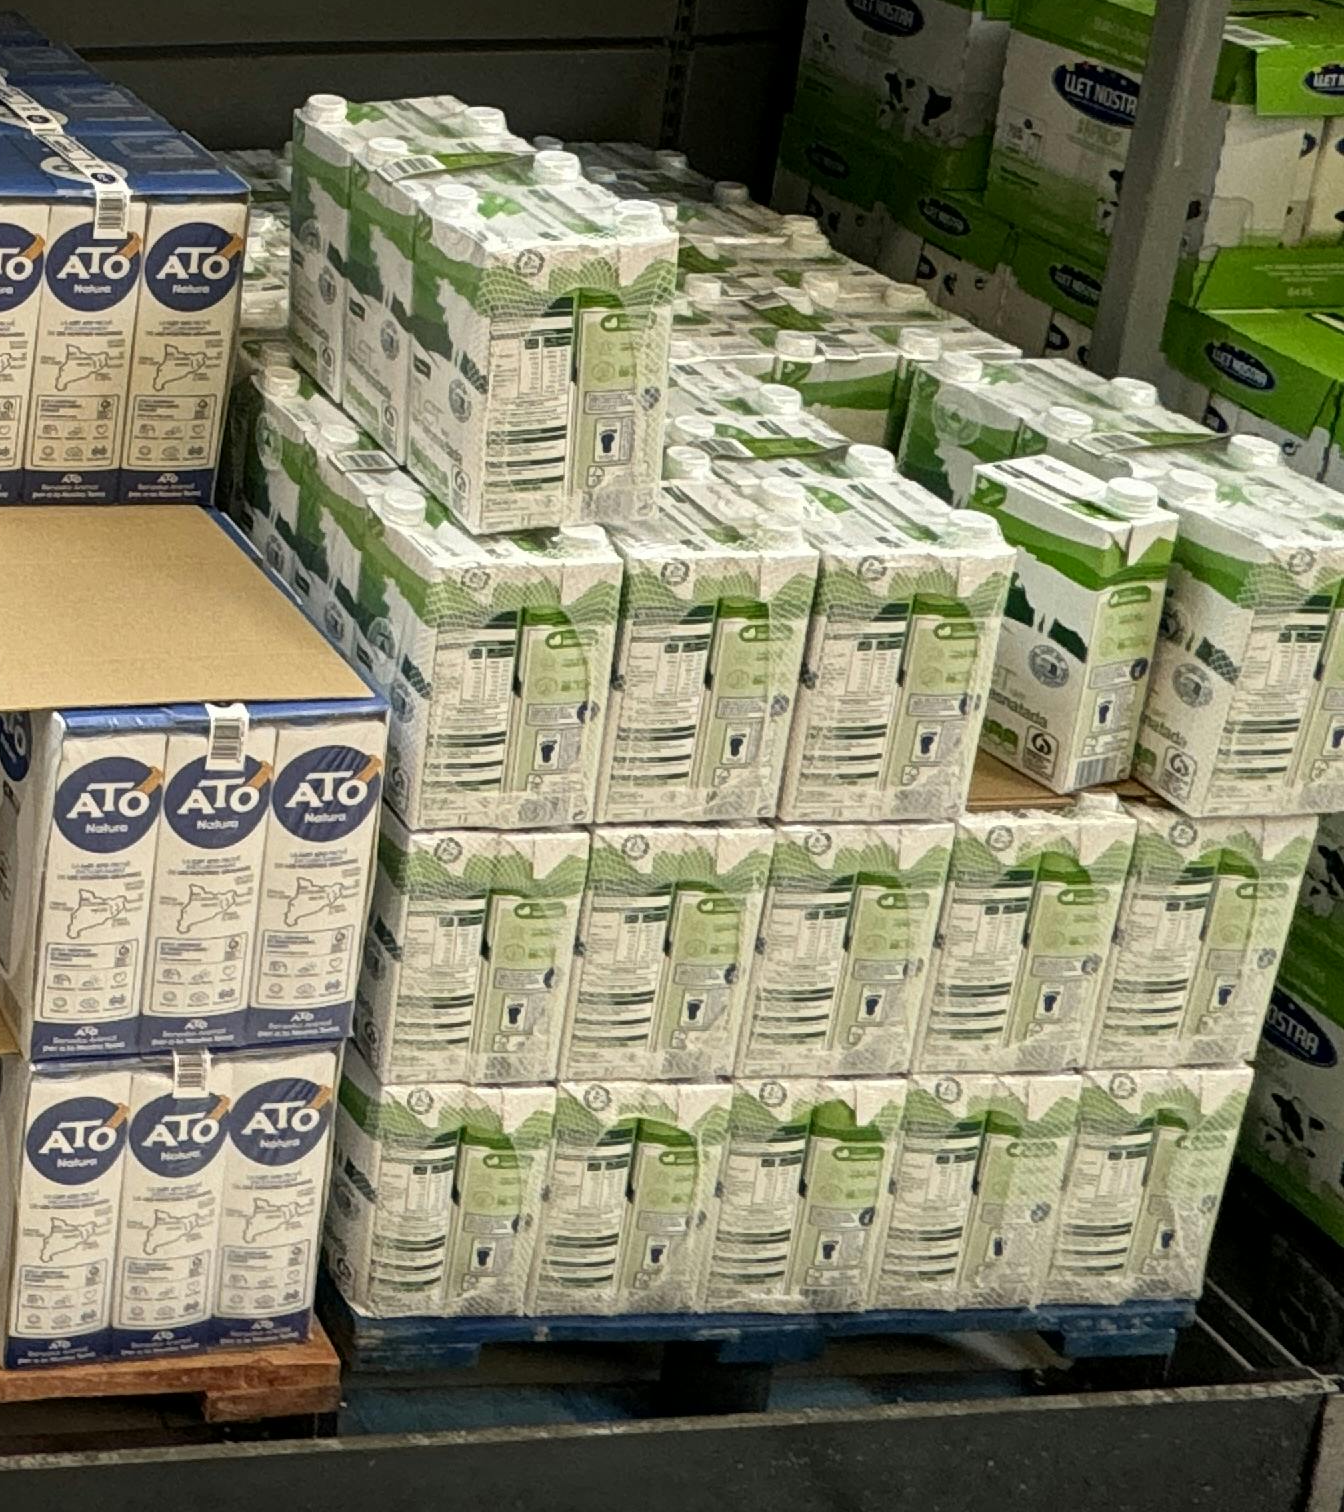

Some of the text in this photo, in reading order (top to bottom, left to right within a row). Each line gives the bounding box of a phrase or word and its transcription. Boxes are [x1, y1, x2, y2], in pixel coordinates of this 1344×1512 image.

[1064, 74, 1093, 107] LLET
[56, 245, 131, 280] ATO
[155, 246, 231, 280] ATO
[66, 782, 150, 819] ATO
[176, 778, 260, 815] ATO
[284, 770, 367, 809] ATO
[196, 817, 239, 830] Natura
[303, 811, 347, 824] Natura
[141, 1113, 220, 1148] ATO
[241, 1100, 320, 1136] ATO
[38, 1119, 117, 1155] ATO
